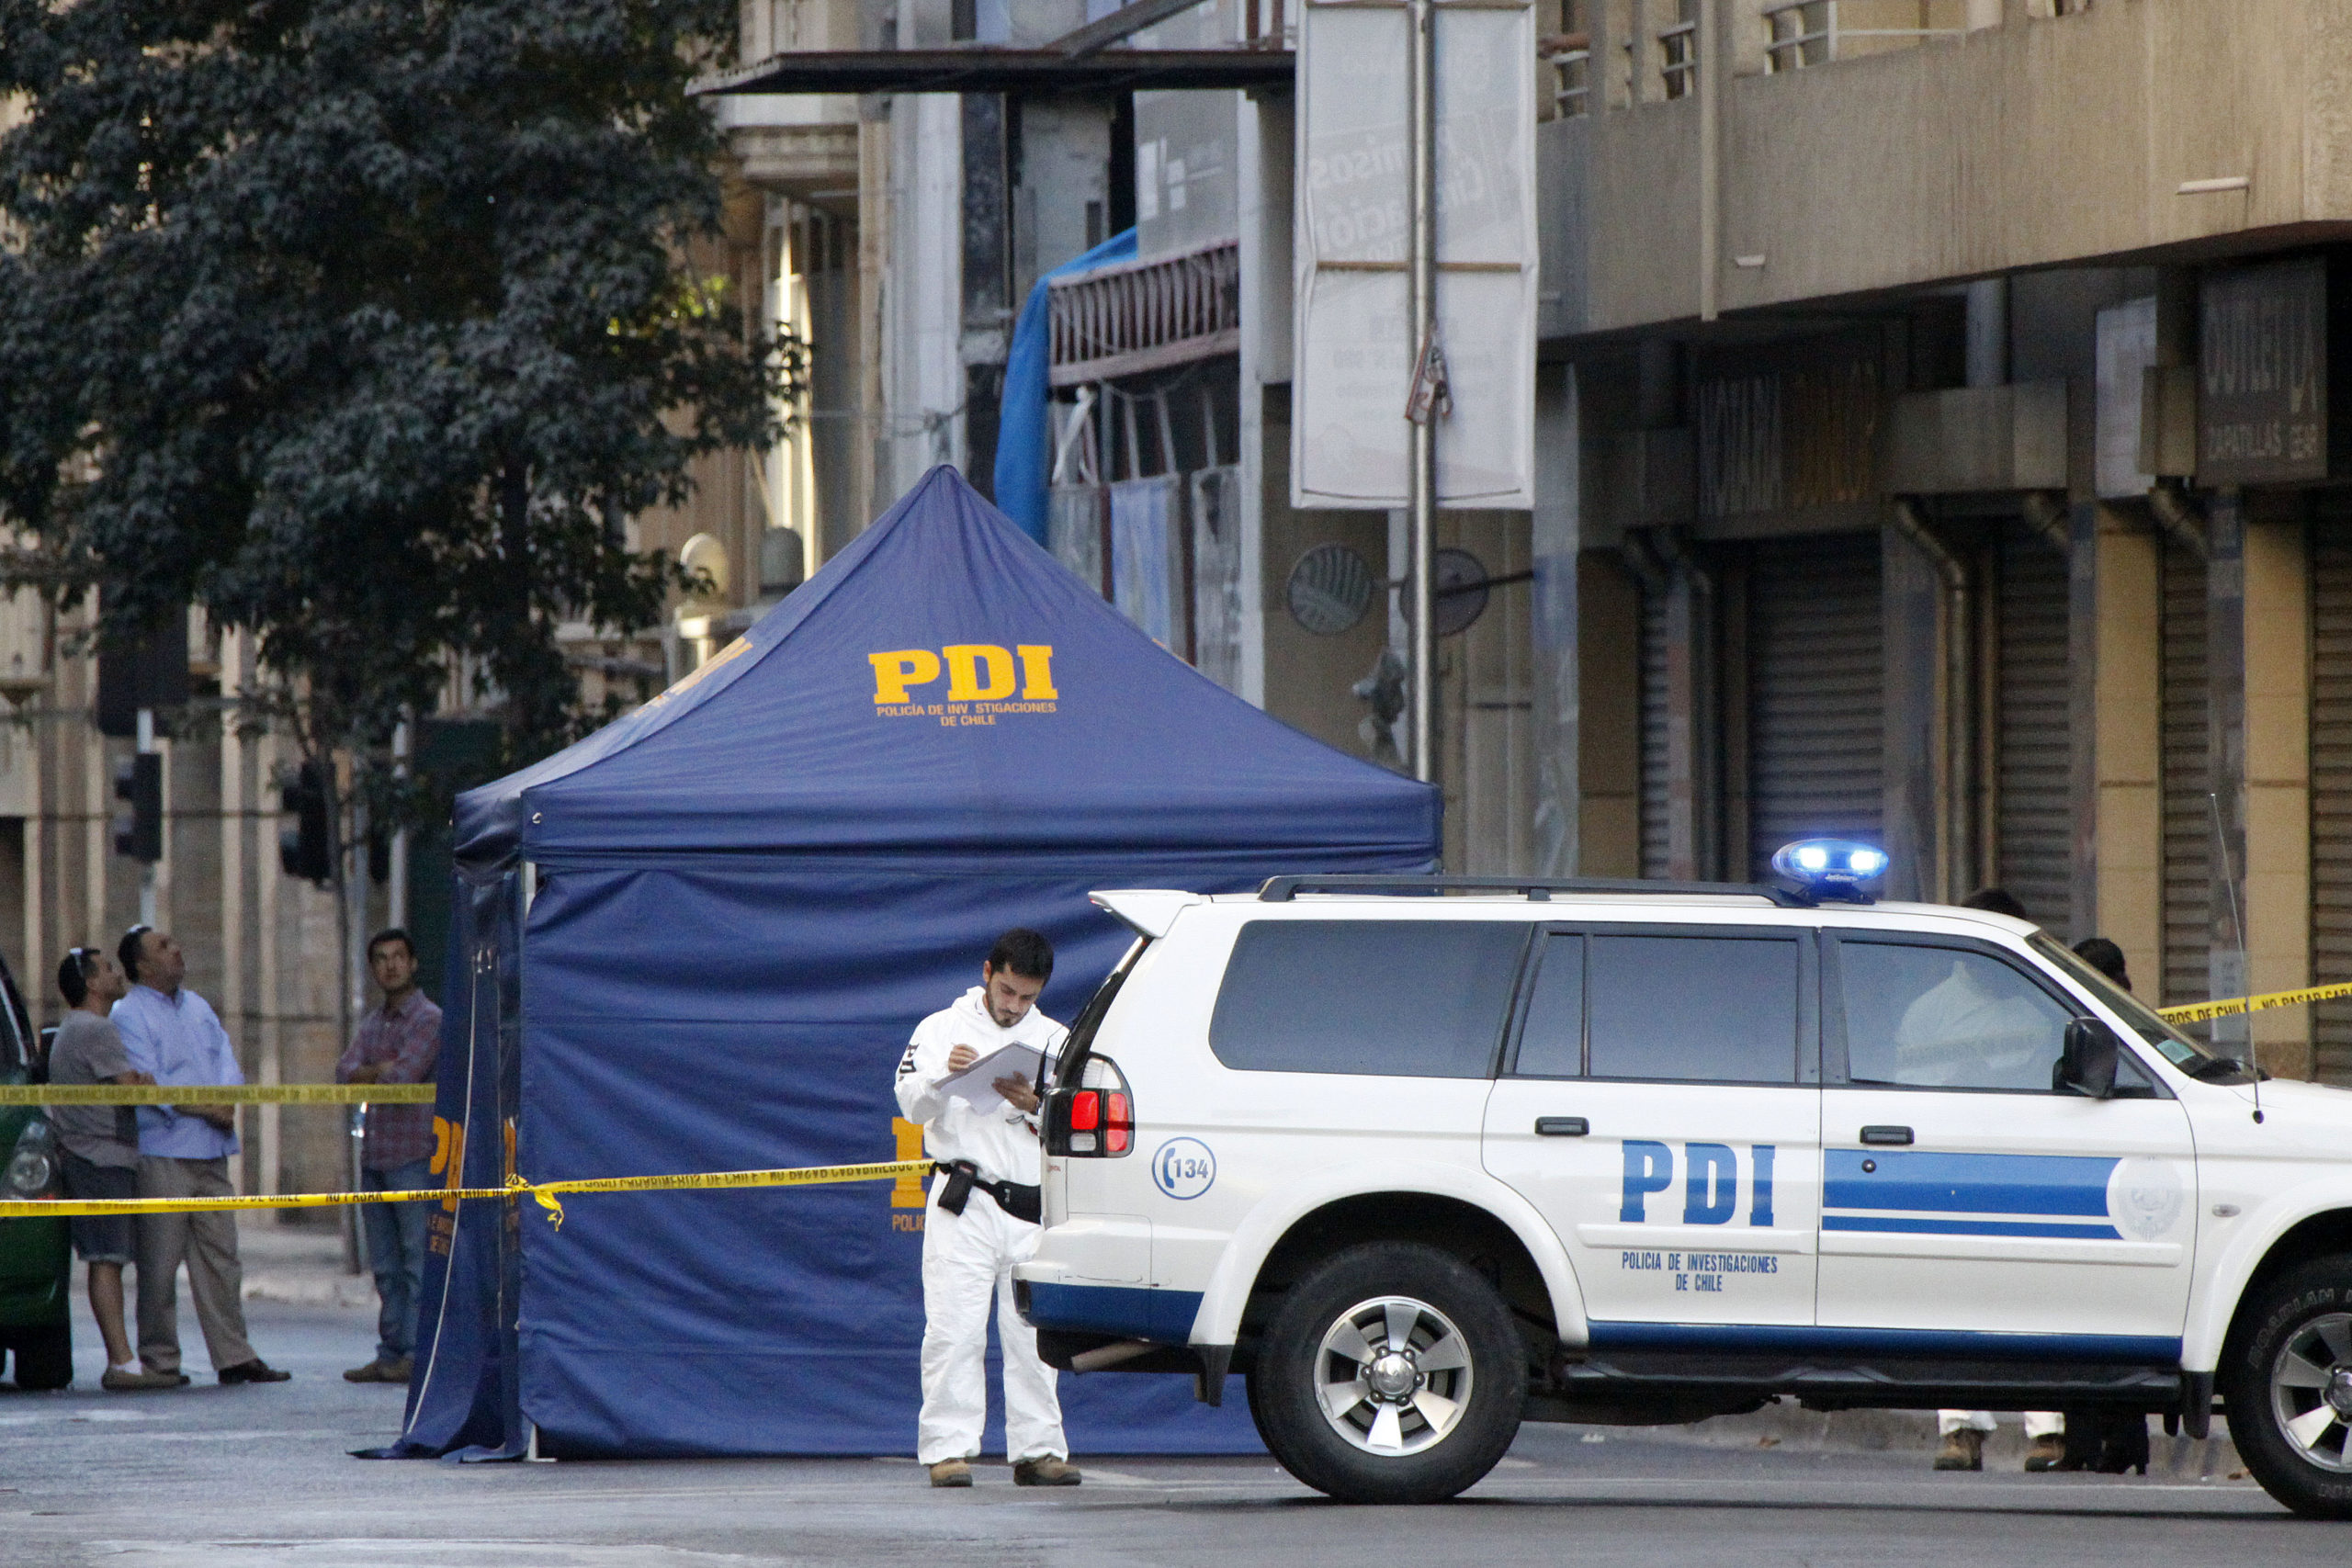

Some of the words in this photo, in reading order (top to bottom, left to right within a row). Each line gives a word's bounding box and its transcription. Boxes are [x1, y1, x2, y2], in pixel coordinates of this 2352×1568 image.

[868, 644, 1058, 704] PDI
[876, 704, 925, 716] POLICÍA
[928, 704, 944, 715] DE
[940, 716, 957, 727] DE
[960, 715, 996, 726] CHILE
[1174, 1158, 1208, 1179] 134
[1620, 1140, 1776, 1226] PDI
[1622, 1251, 1661, 1270] POLICIA
[1668, 1253, 1681, 1270] DE
[1688, 1254, 1778, 1273] INVESTIGACIONES
[1676, 1274, 1688, 1291] DE
[1695, 1274, 1723, 1292] CHILE
